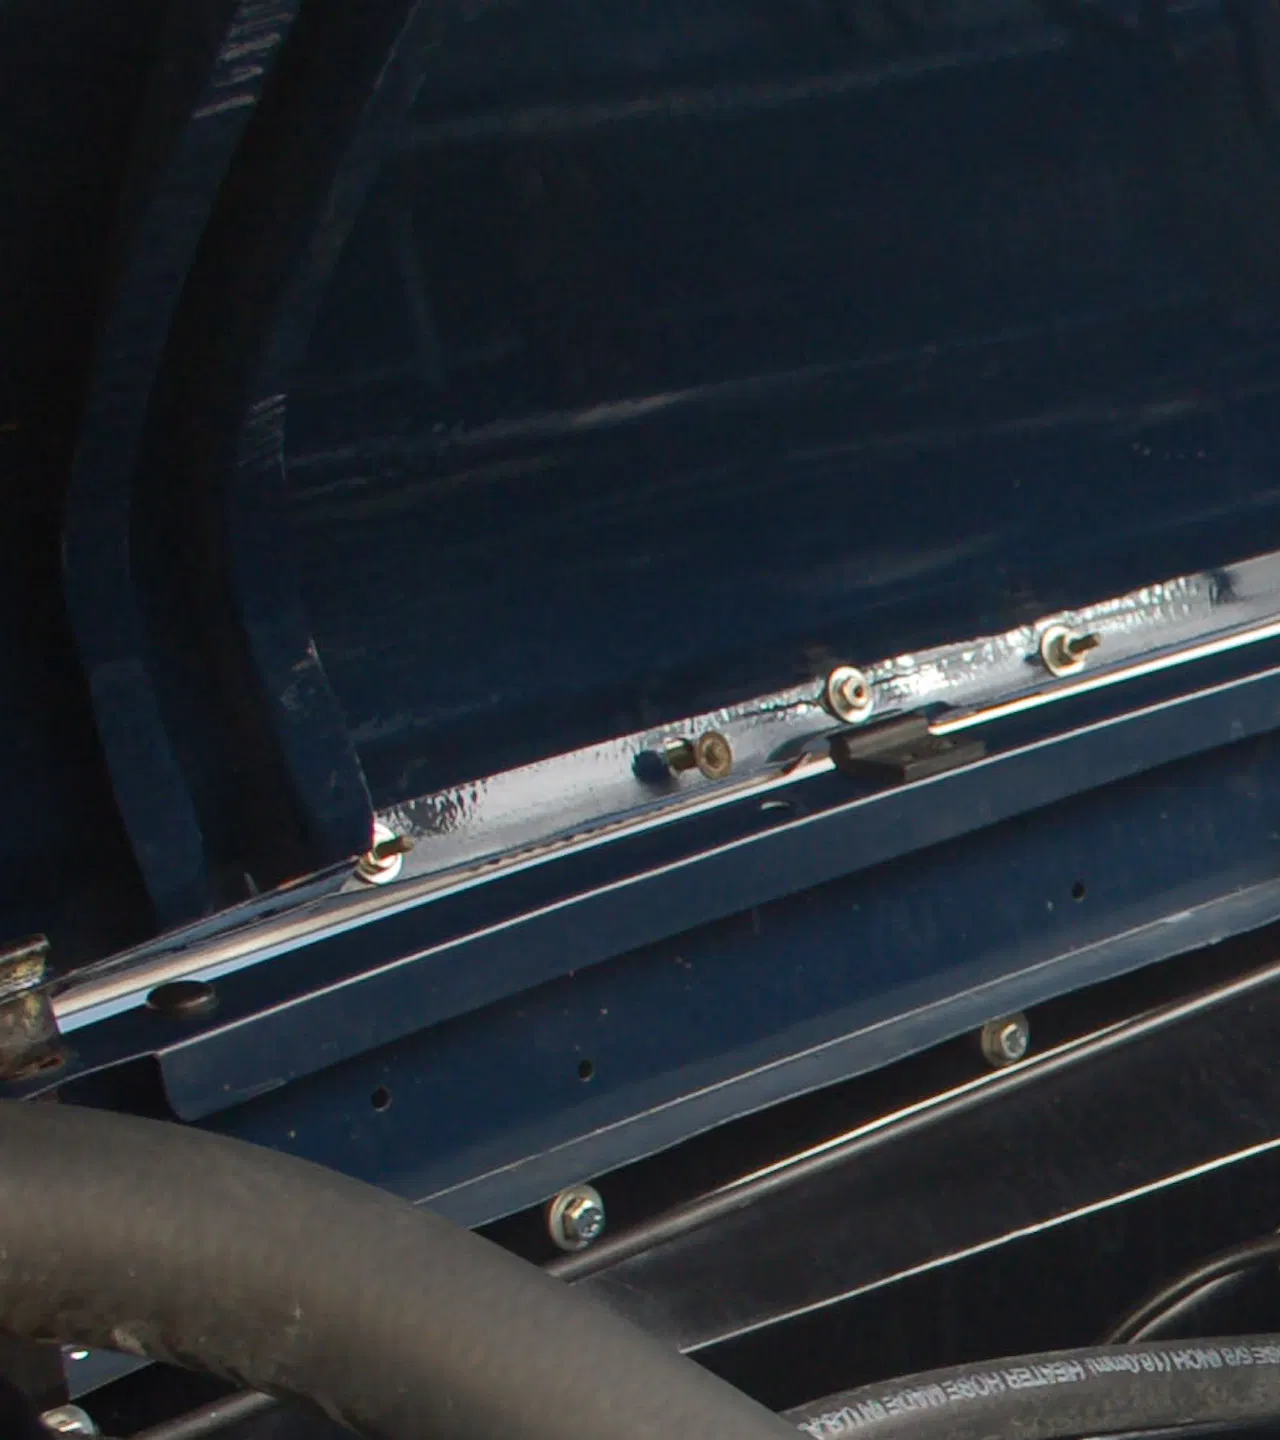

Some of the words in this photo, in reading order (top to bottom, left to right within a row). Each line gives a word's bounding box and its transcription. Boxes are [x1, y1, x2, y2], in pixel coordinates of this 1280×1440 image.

[1172, 1348, 1222, 1371] INCH
[942, 1372, 1005, 1399] HOSE
[1004, 1359, 1086, 1388] HEATER
[857, 1400, 889, 1423] IN
[883, 1385, 945, 1414] MADE
